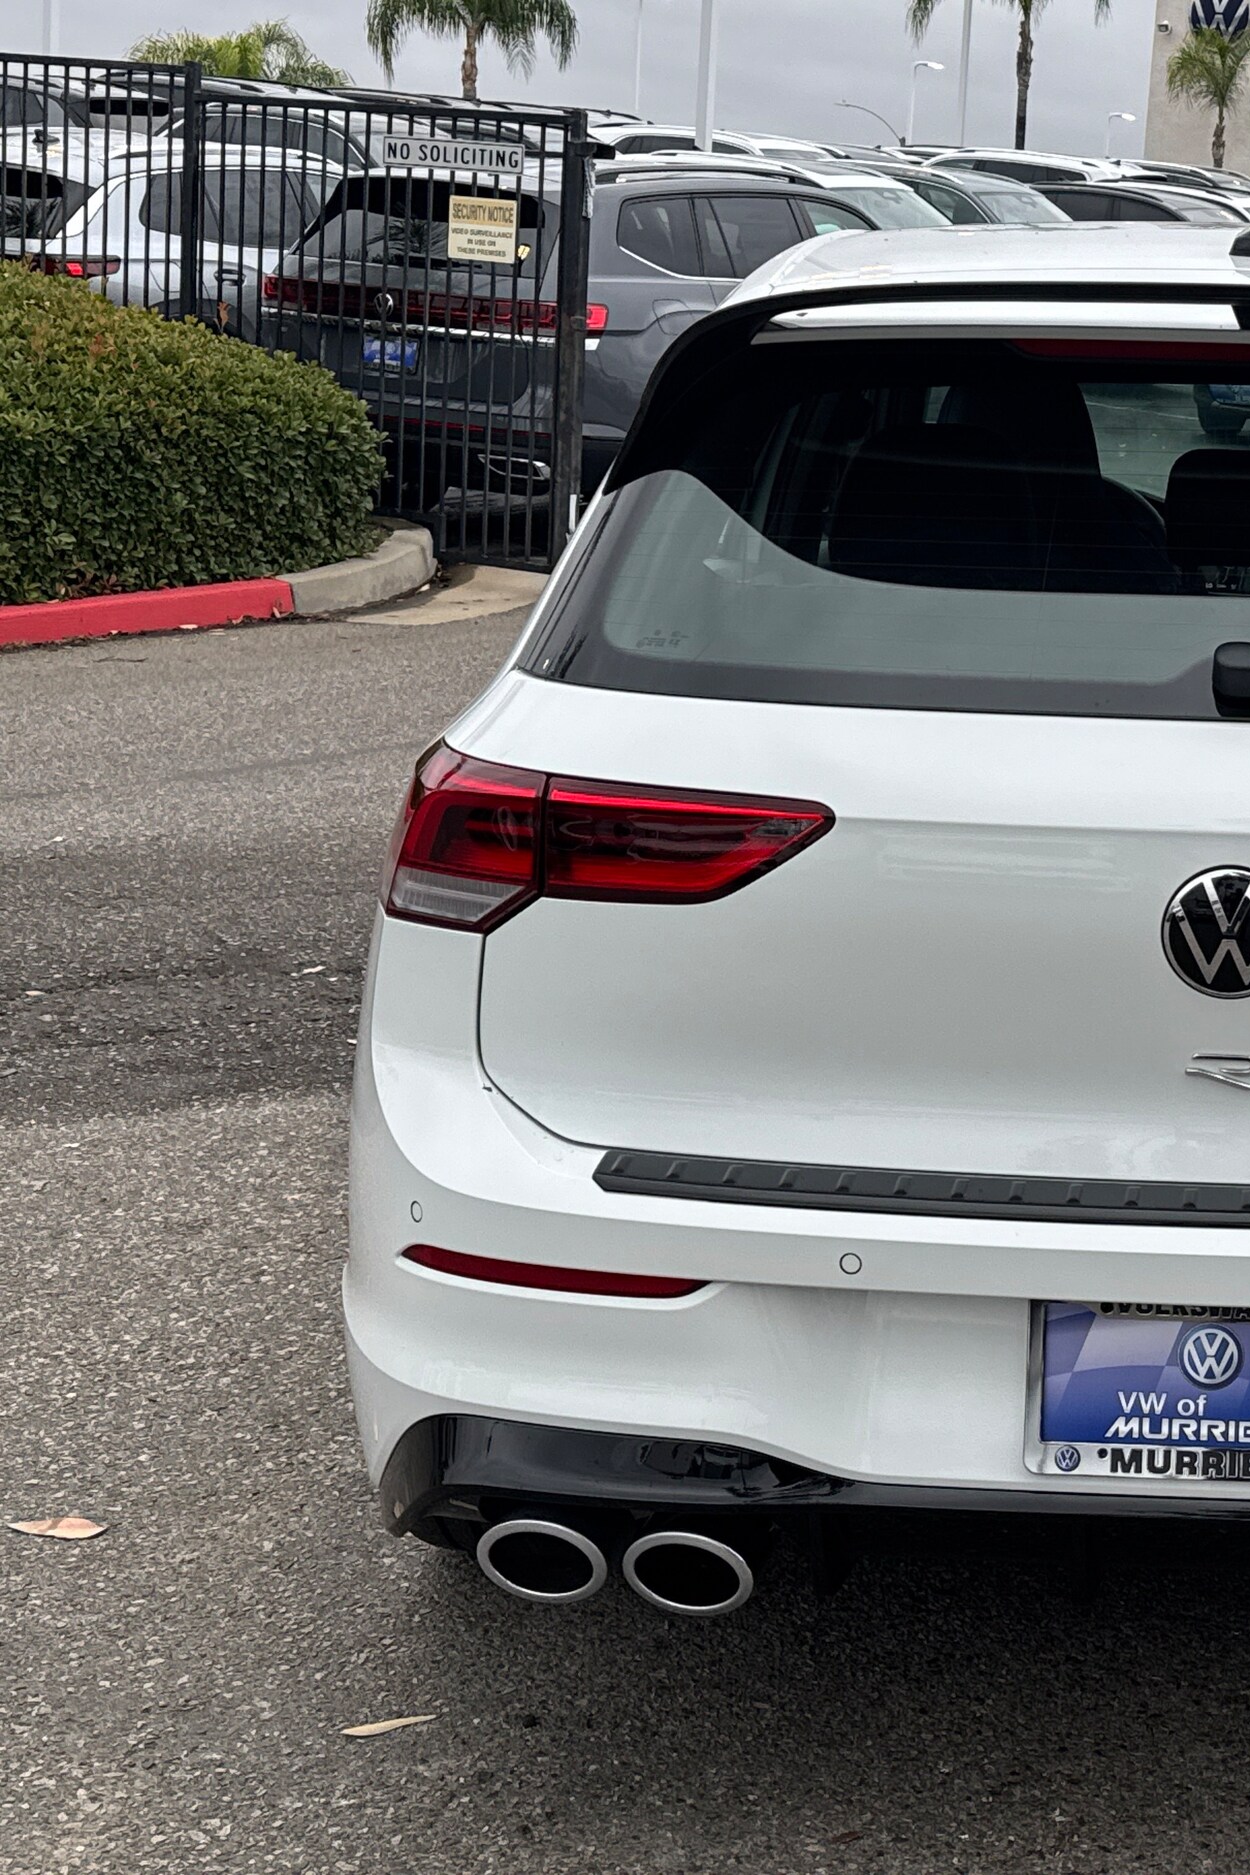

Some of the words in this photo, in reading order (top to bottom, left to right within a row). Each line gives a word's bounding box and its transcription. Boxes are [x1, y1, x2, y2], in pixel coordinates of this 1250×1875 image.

[387, 142, 411, 160] NO
[418, 144, 519, 169] SOLICITING
[452, 203, 486, 222] SECURITY
[487, 206, 514, 224] NOTICE
[451, 227, 469, 235] VIDEO
[469, 229, 514, 239] SURVEILLANCE
[1117, 1391, 1167, 1415] VW
[1177, 1394, 1207, 1416] of
